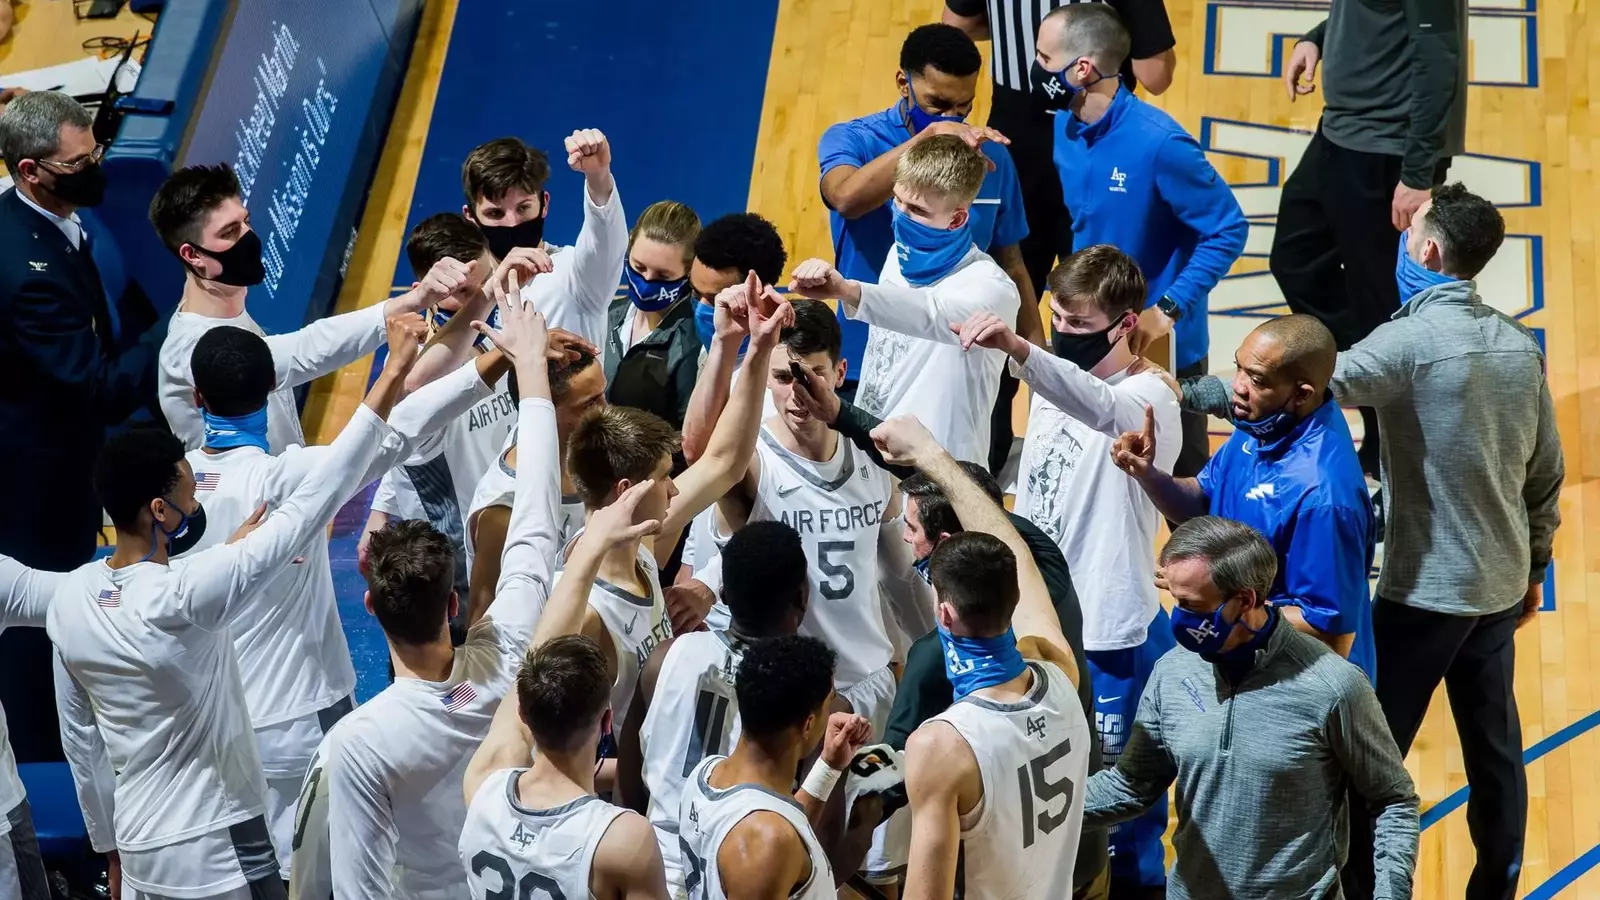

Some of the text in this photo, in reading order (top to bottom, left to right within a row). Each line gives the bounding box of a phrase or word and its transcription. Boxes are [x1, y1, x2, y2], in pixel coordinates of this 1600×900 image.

[235, 76, 275, 208] ockheed
[268, 152, 312, 251] Mission
[294, 125, 320, 170] is
[1110, 166, 1127, 187] AF
[657, 286, 680, 303] AF
[468, 391, 516, 432] AIR FOR
[819, 500, 884, 534] FORCE
[817, 540, 855, 601] 5
[1186, 618, 1220, 645] AF
[1025, 715, 1046, 741] AF
[1017, 737, 1075, 850] 15
[509, 821, 536, 852] AF
